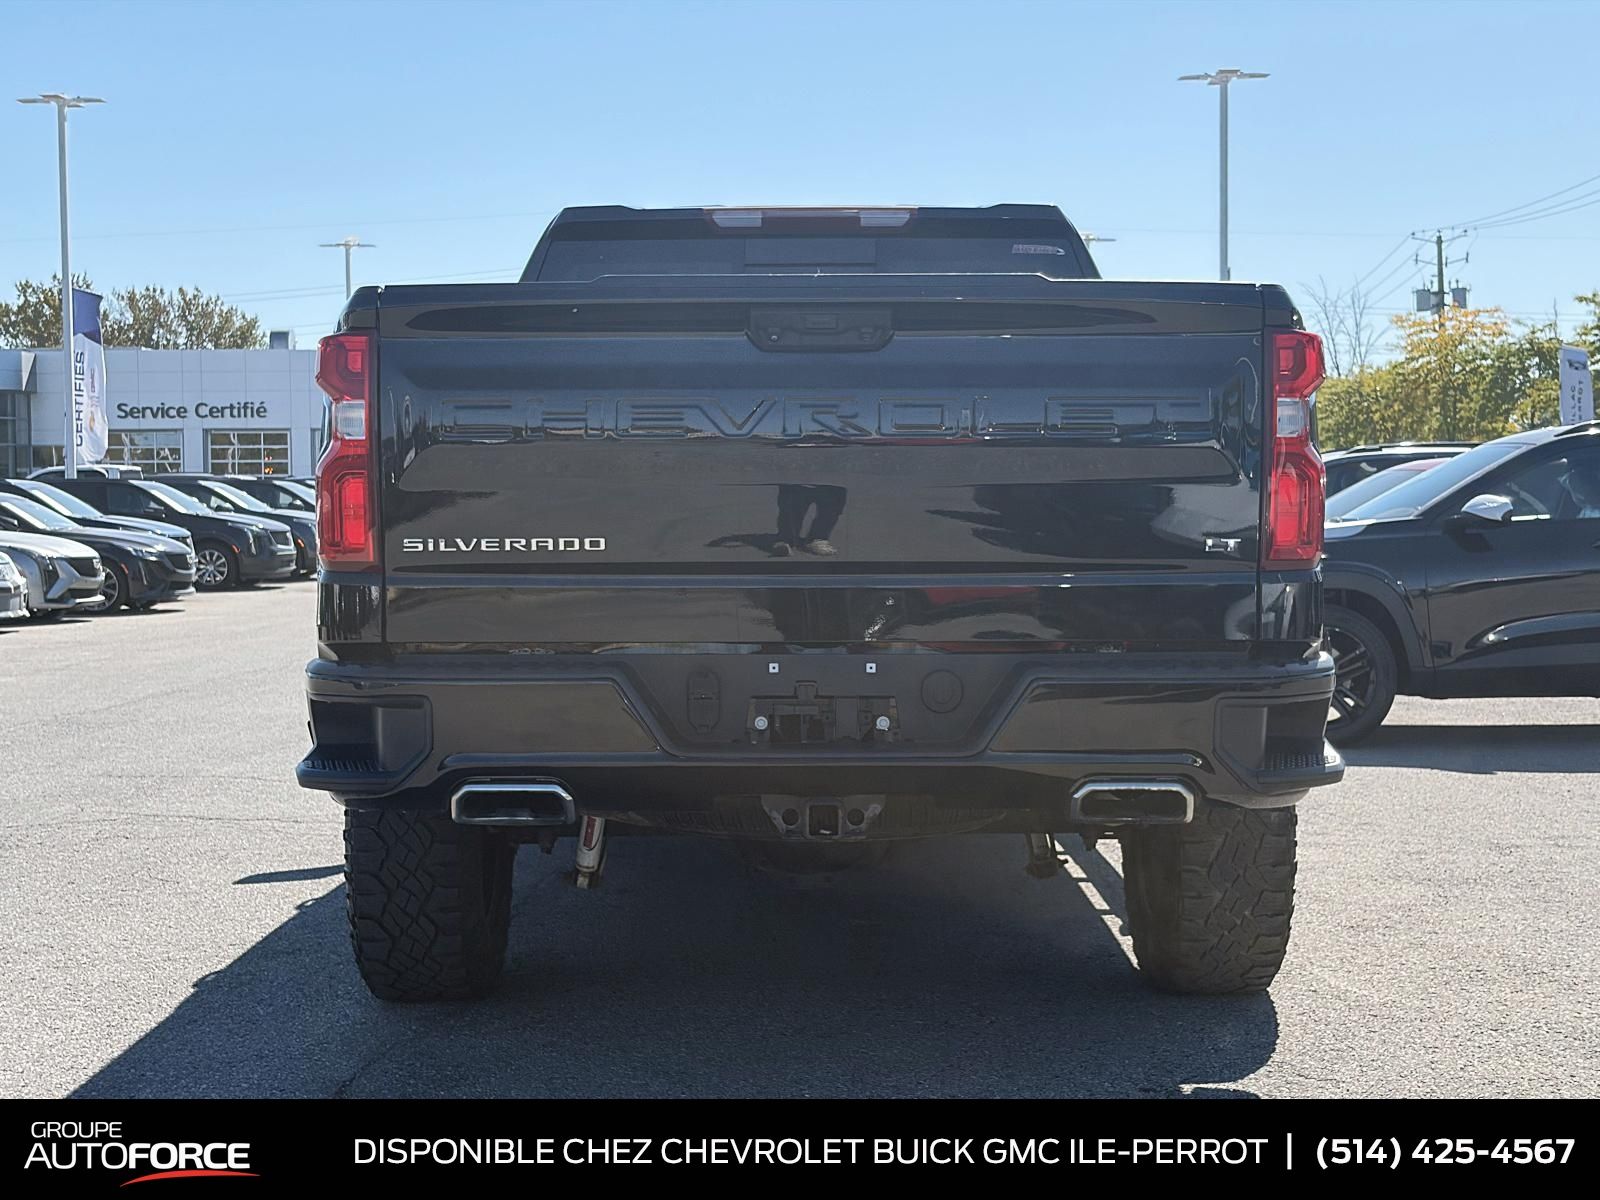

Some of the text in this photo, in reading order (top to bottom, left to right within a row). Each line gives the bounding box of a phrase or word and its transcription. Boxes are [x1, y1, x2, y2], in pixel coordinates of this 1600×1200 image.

[116, 401, 268, 419] Service Certifié
[439, 395, 1211, 439] CHEVROLET
[402, 537, 606, 552] SILVERADO
[1203, 537, 1242, 552] LT
